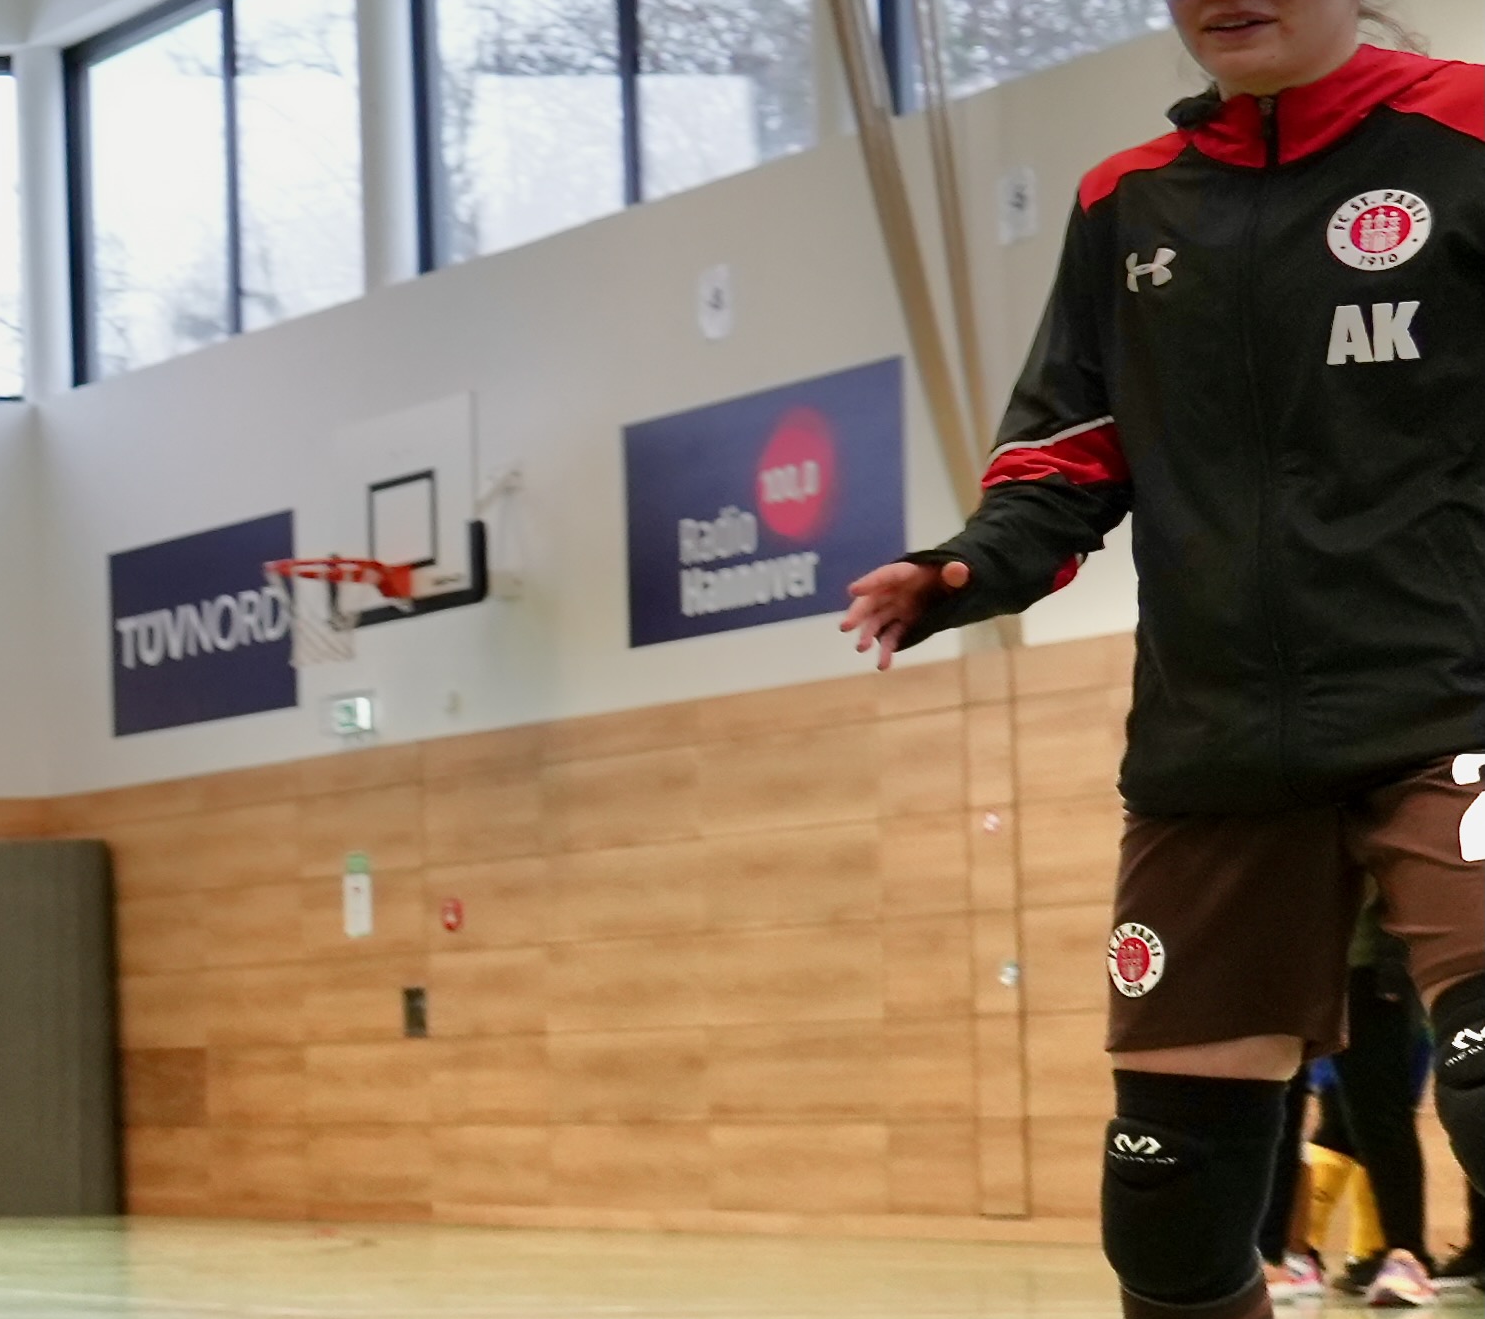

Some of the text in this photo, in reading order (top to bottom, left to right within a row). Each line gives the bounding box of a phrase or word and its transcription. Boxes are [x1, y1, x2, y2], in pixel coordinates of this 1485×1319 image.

[1326, 301, 1421, 365] AK
[677, 503, 758, 566] Radio
[679, 550, 821, 618] Hannover
